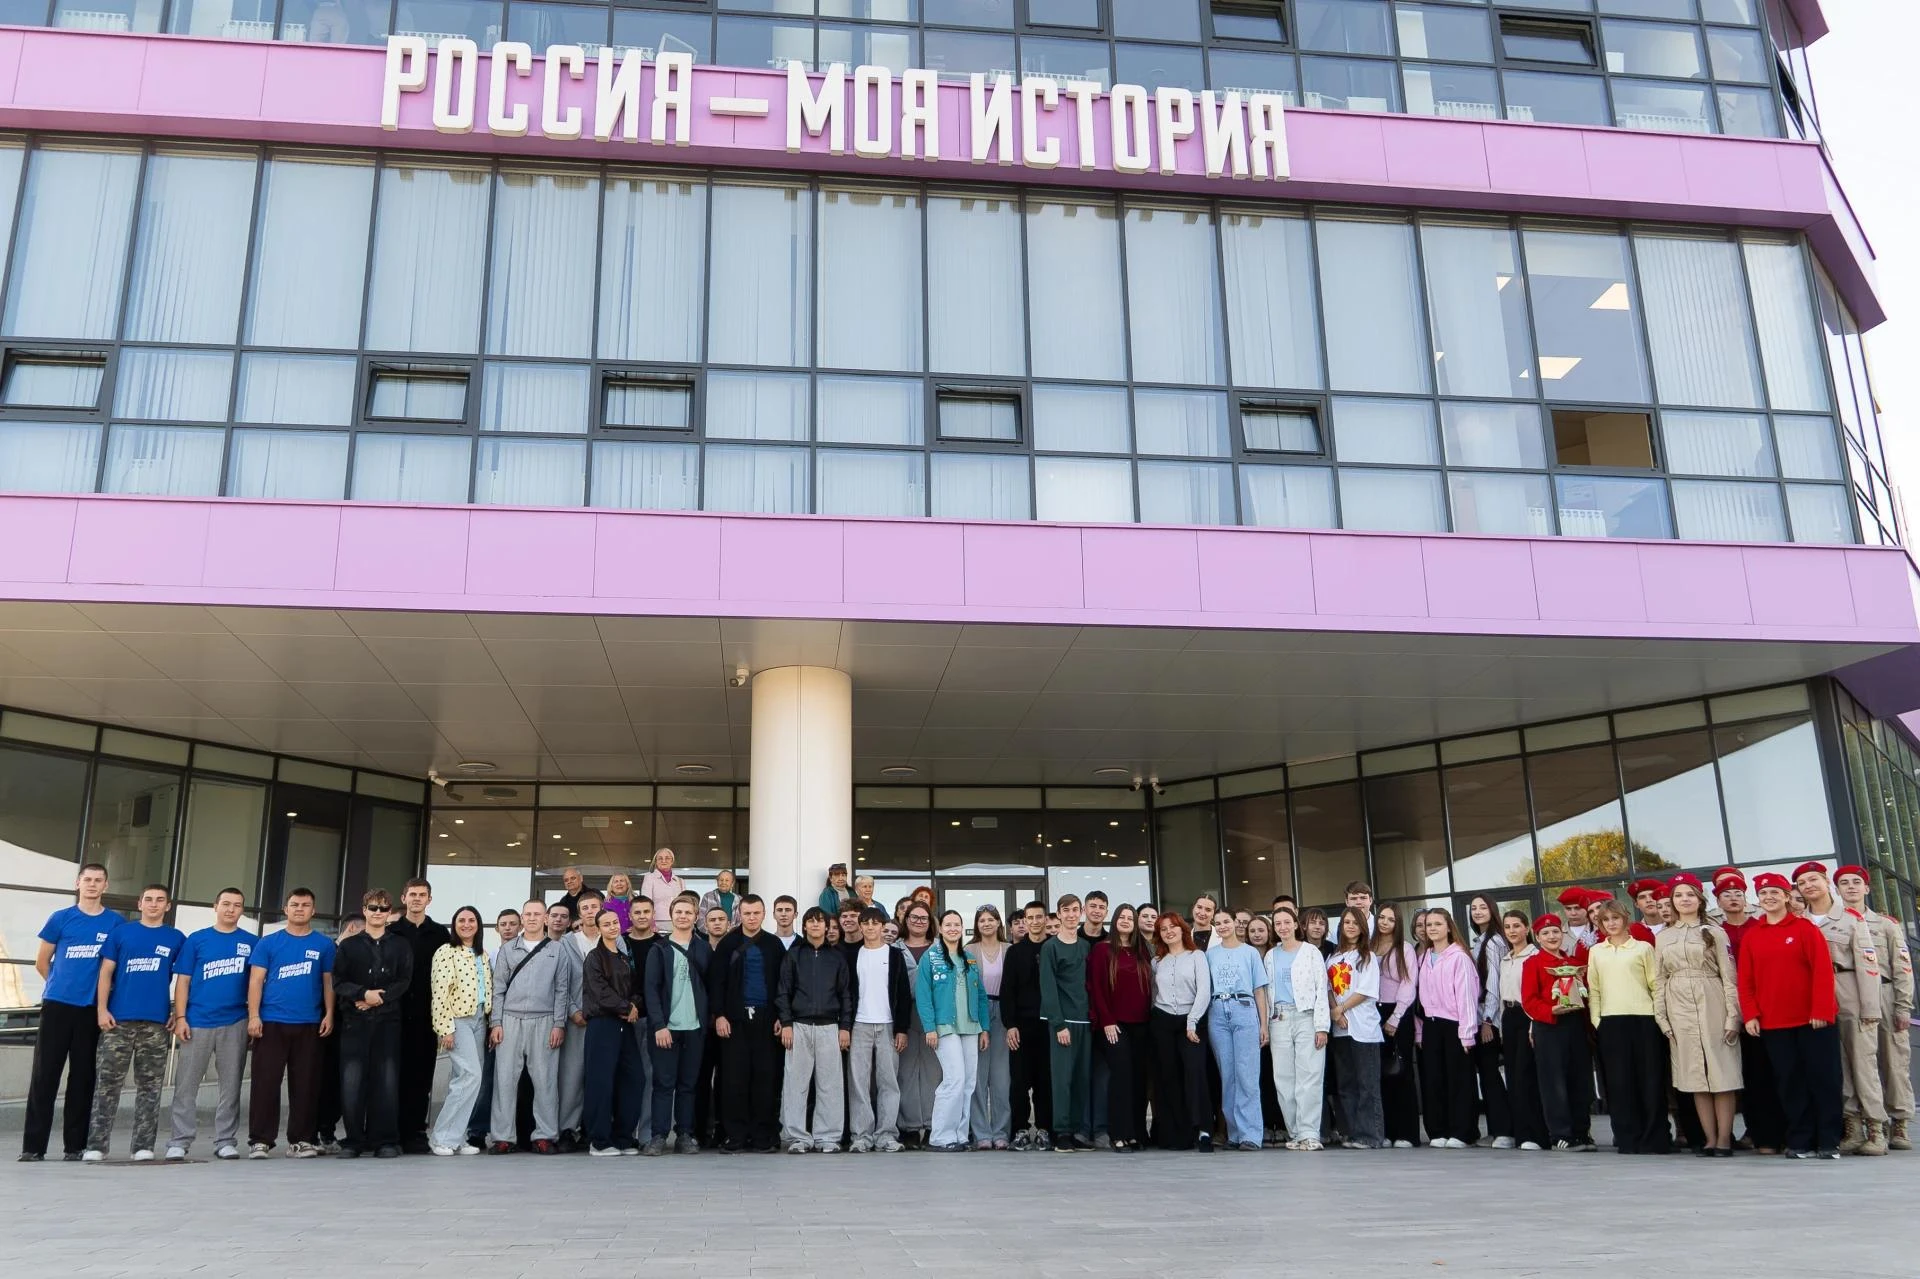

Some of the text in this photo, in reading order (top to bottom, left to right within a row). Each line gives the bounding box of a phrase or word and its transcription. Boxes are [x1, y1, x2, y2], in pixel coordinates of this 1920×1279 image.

[381, 35, 693, 147] РОССИЯ
[787, 60, 939, 162] МОЯ
[970, 73, 1290, 182] ИСТОРИЯ
